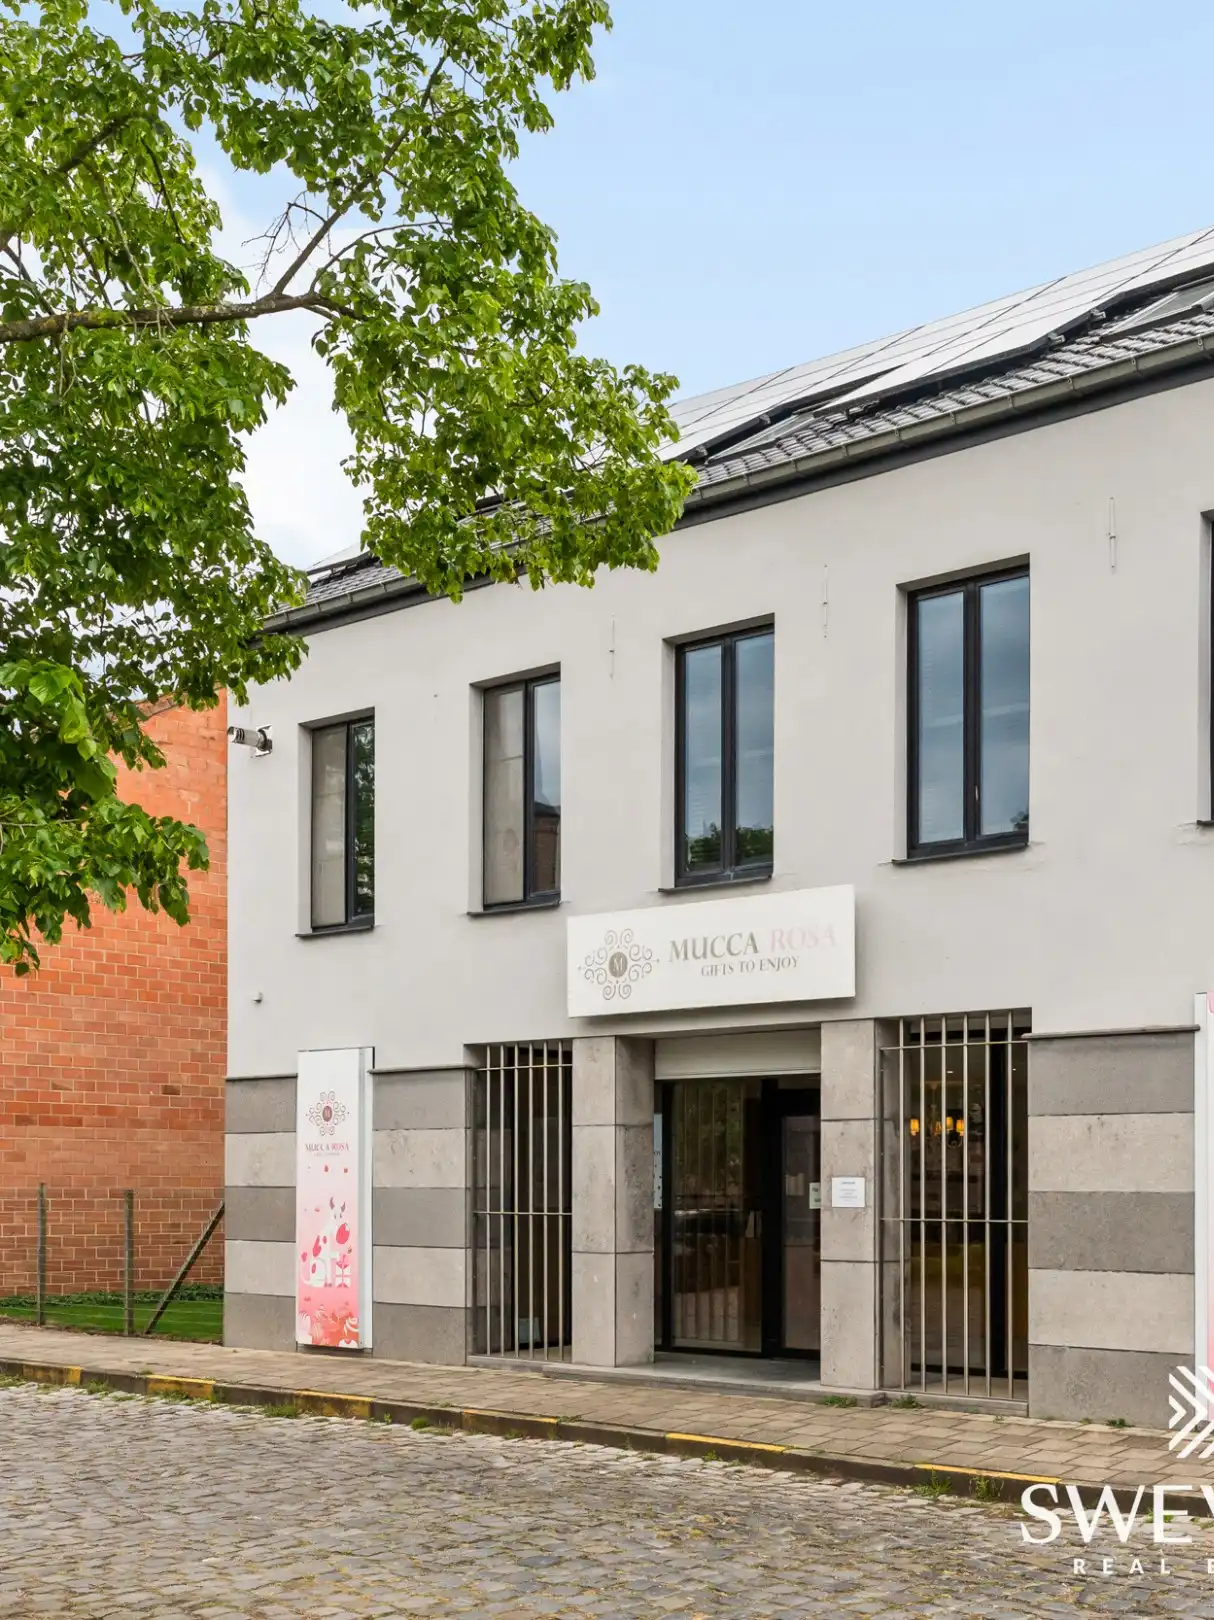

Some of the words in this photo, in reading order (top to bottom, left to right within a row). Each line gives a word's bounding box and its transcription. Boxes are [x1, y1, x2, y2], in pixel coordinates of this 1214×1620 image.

[668, 931, 760, 963] MUCCA
[769, 924, 837, 952] ROSA
[701, 962, 734, 977] GIFTS
[739, 960, 756, 973] TO
[759, 955, 800, 972] ENJOY
